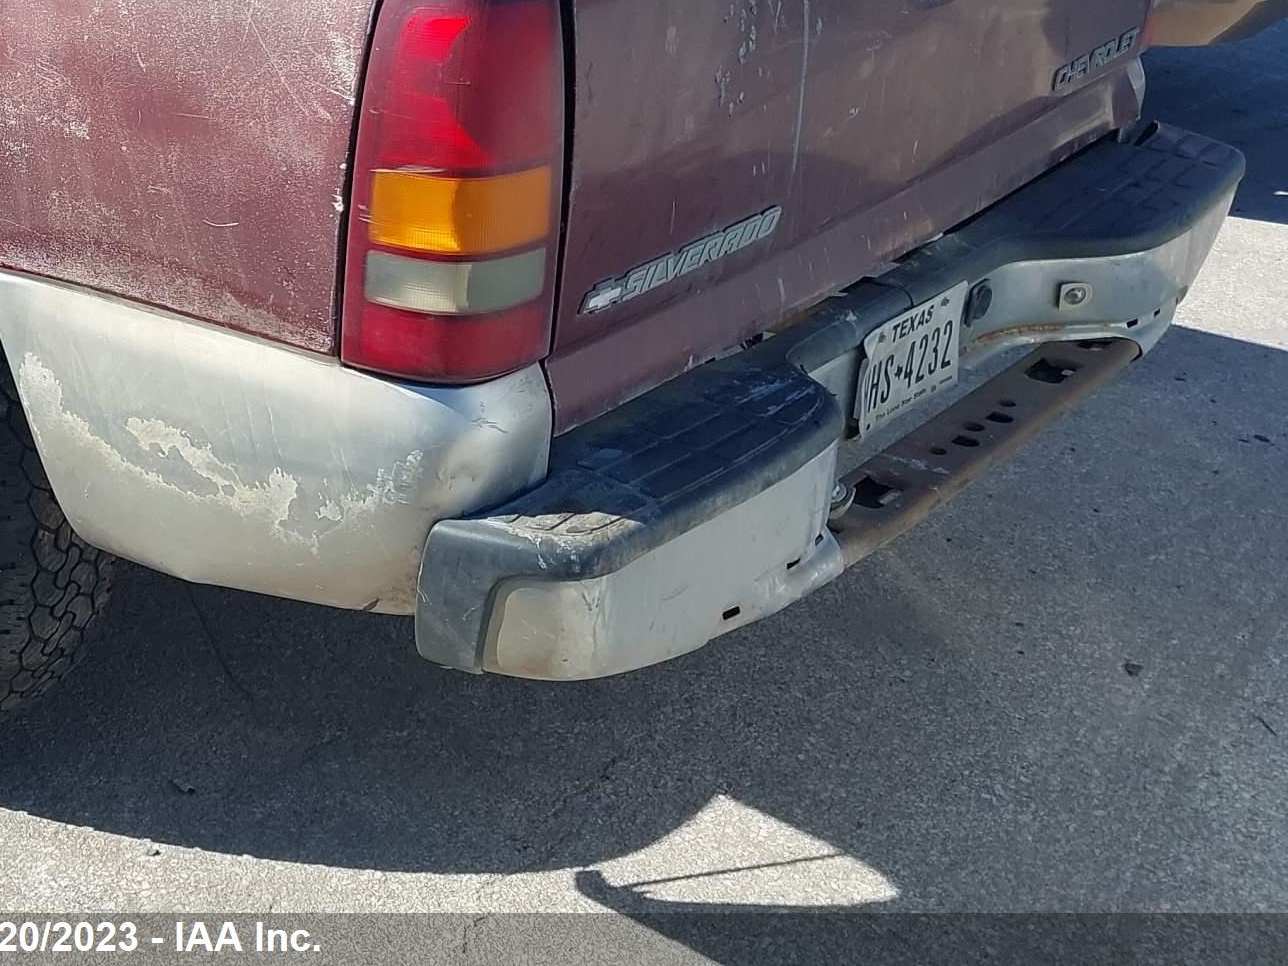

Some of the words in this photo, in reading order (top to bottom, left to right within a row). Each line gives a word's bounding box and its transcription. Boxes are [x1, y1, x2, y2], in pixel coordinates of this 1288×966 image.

[1052, 26, 1142, 91] CHEVROLET
[621, 205, 782, 302] SILVERADO
[892, 305, 934, 343] TEXAS
